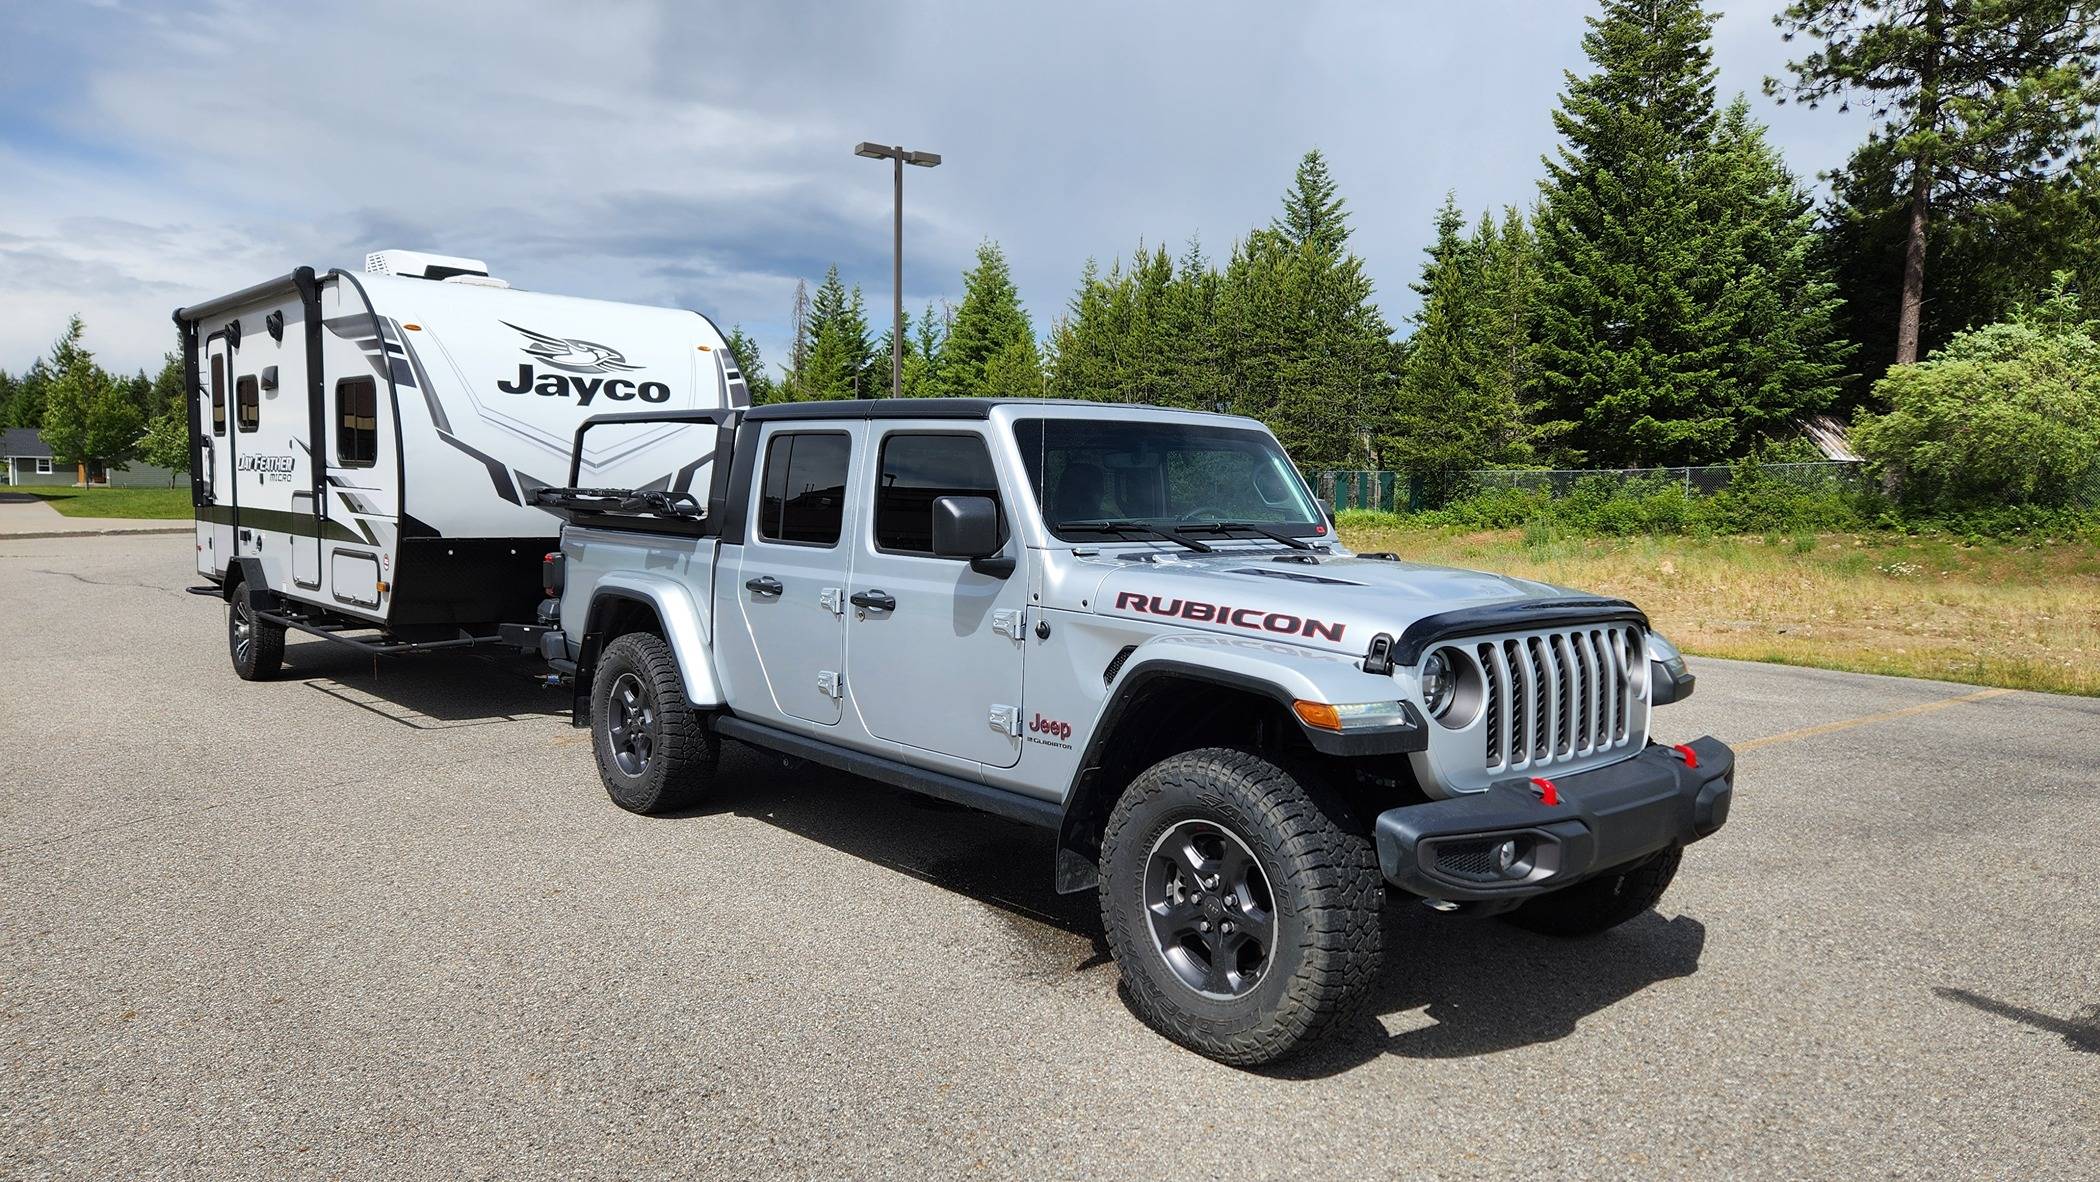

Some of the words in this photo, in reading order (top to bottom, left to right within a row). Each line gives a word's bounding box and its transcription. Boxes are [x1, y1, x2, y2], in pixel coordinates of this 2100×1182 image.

[497, 364, 671, 407] Jayco
[238, 453, 254, 471] JAY
[254, 453, 295, 472] FEATHER
[269, 473, 292, 482] MICRO
[1115, 591, 1347, 643] RUBICON
[1029, 713, 1072, 741] Jeep
[1033, 738, 1073, 750] GLADIATOR
